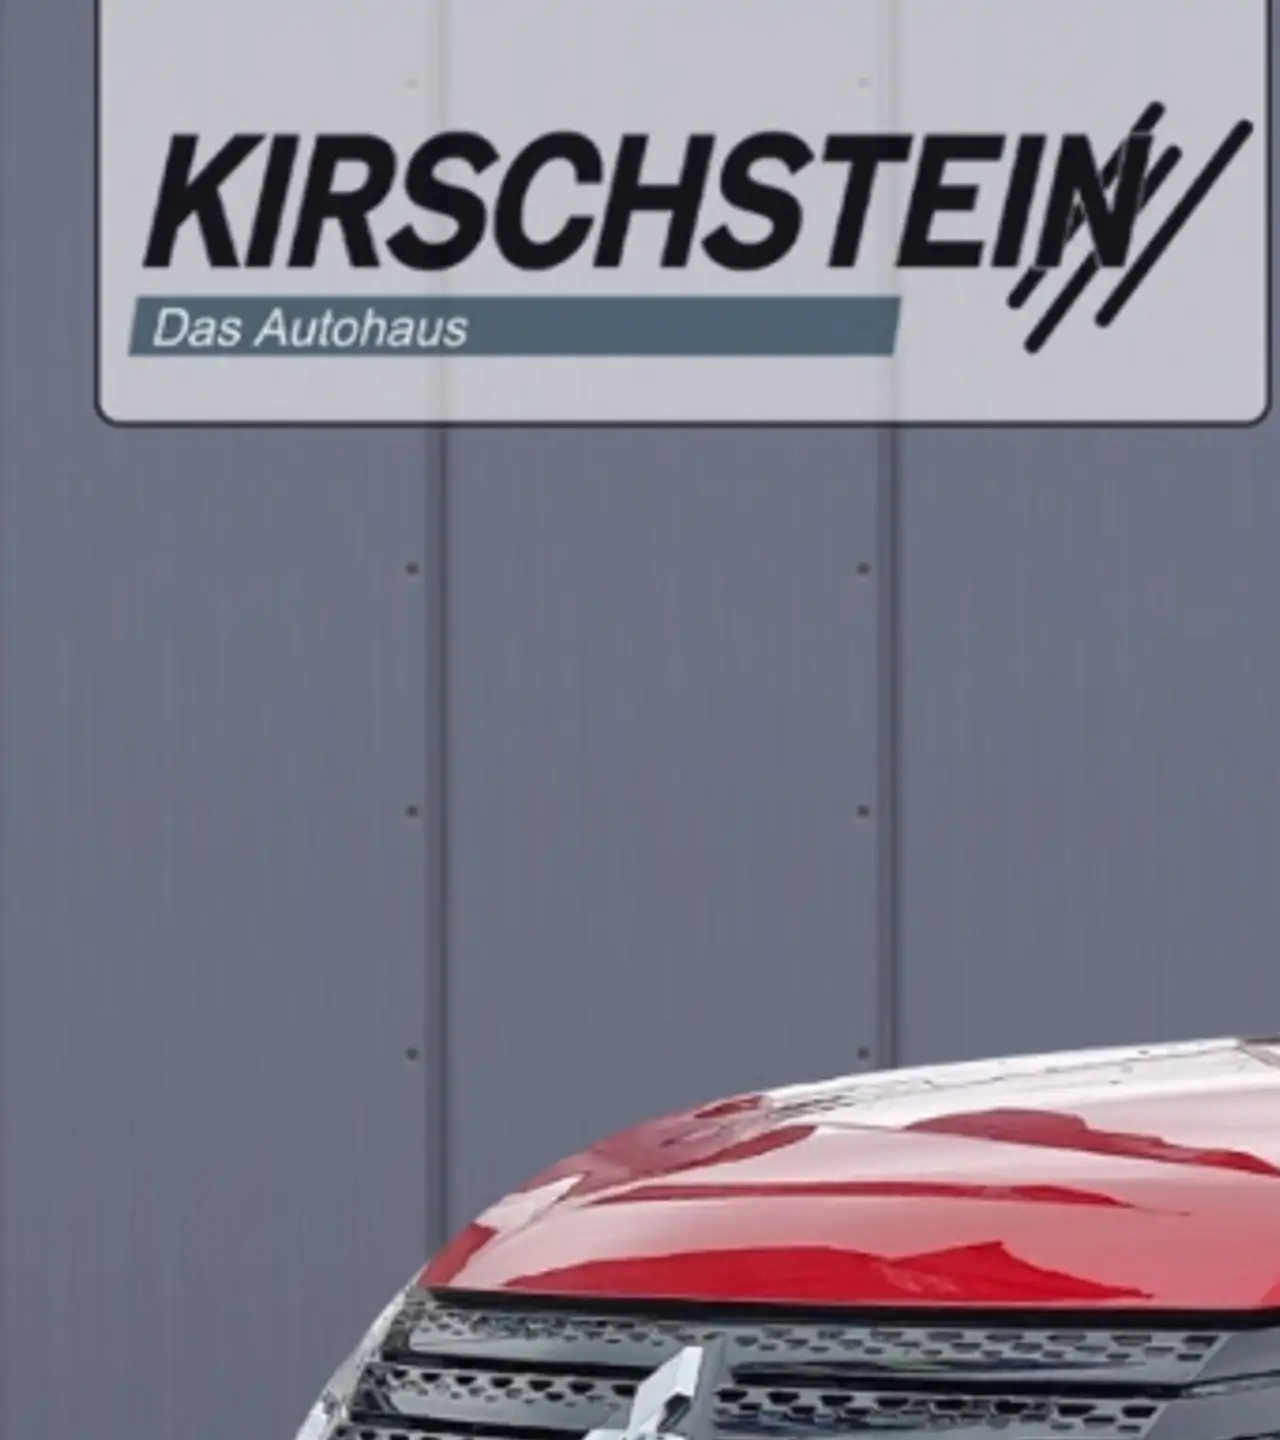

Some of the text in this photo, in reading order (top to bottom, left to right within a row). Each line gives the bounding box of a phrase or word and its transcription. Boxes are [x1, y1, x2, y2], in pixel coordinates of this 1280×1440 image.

[142, 131, 1155, 272] KIRSCHSTEIN
[152, 306, 469, 348] Das Autohaus
